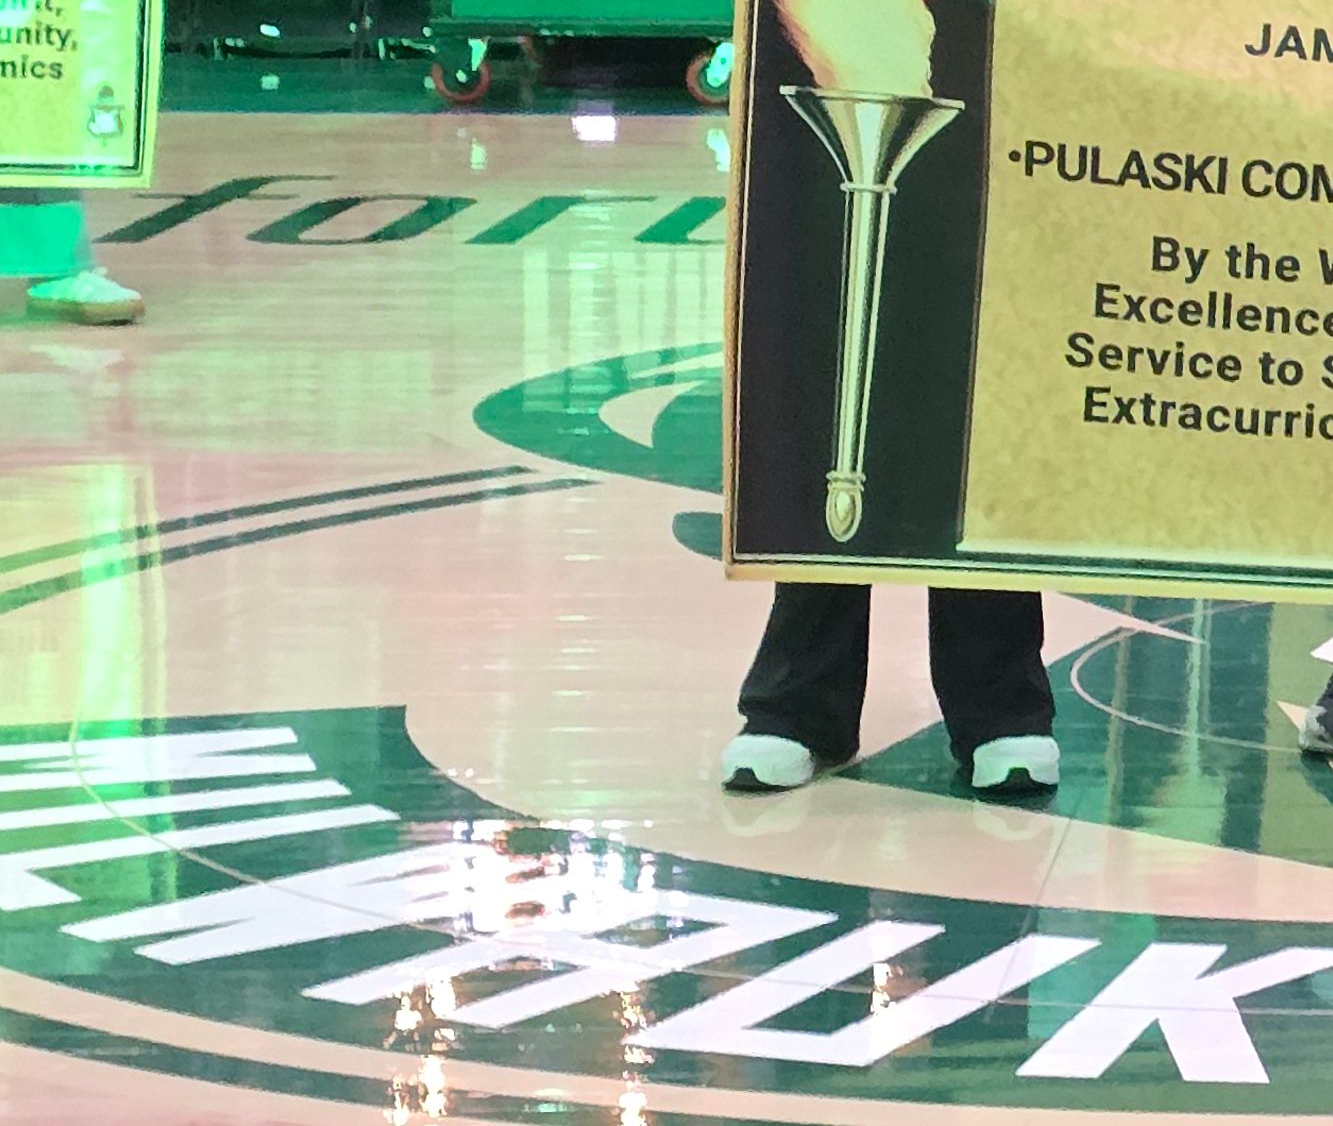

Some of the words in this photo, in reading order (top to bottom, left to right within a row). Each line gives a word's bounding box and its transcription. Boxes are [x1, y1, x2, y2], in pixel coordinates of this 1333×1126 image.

[1151, 235, 1210, 284] By
[1225, 242, 1301, 282] the
[1064, 332, 1242, 382] Service
[1258, 351, 1304, 386] to
